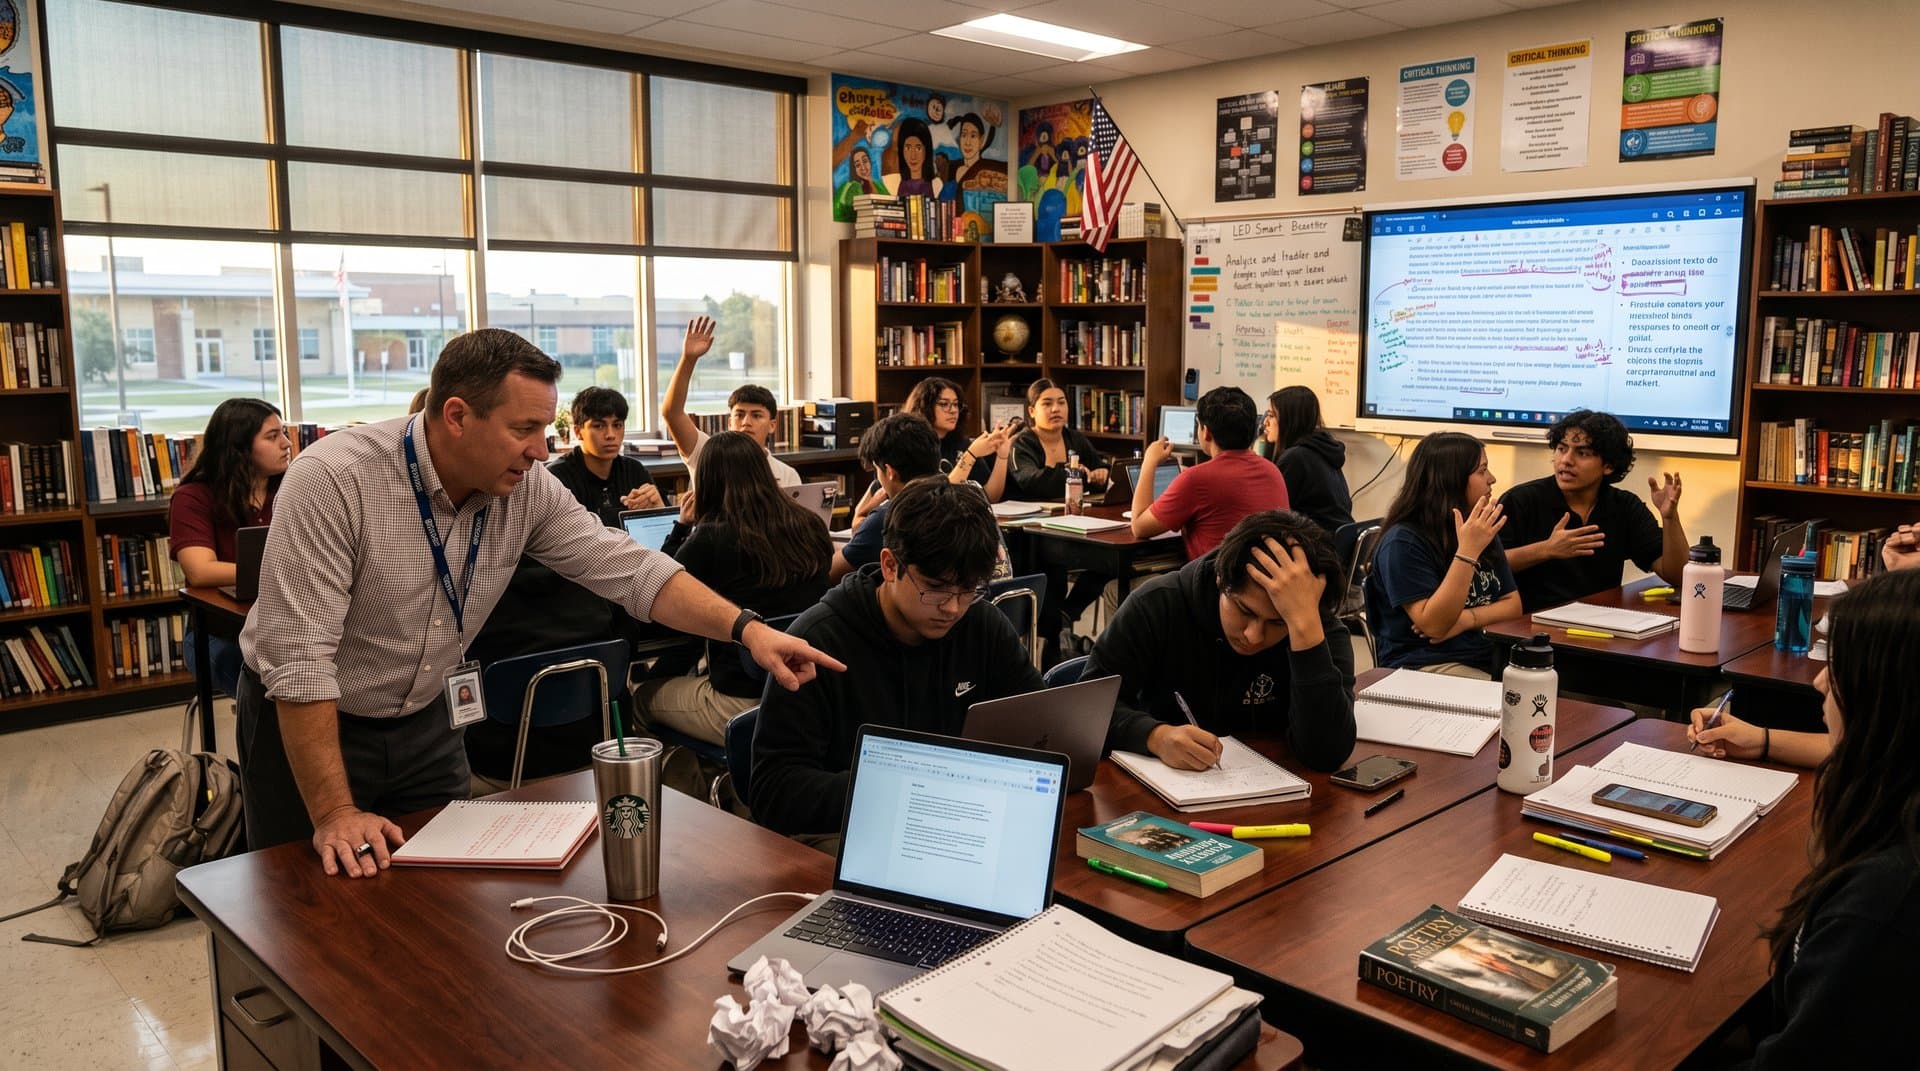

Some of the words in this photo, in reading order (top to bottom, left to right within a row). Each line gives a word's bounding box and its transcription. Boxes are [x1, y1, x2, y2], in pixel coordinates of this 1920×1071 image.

[1630, 31, 1669, 44] CRITICAL
[1673, 23, 1715, 38] THINKING
[1511, 51, 1546, 64] CRITICAL
[1547, 45, 1586, 59] THINKING
[1403, 67, 1434, 79] CRITICAL
[1436, 62, 1471, 75] THINKING
[1233, 223, 1250, 238] LED
[1255, 223, 1283, 236] Smart
[1262, 253, 1276, 265] and
[1313, 248, 1330, 259] and
[1707, 256, 1718, 264] do
[1704, 300, 1725, 310] your
[1672, 323, 1681, 331] to
[1689, 346, 1703, 354] the
[1658, 357, 1672, 365] the
[1699, 369, 1716, 377] and
[1386, 915, 1455, 957] POETRY
[1376, 966, 1439, 1002] POETRY
